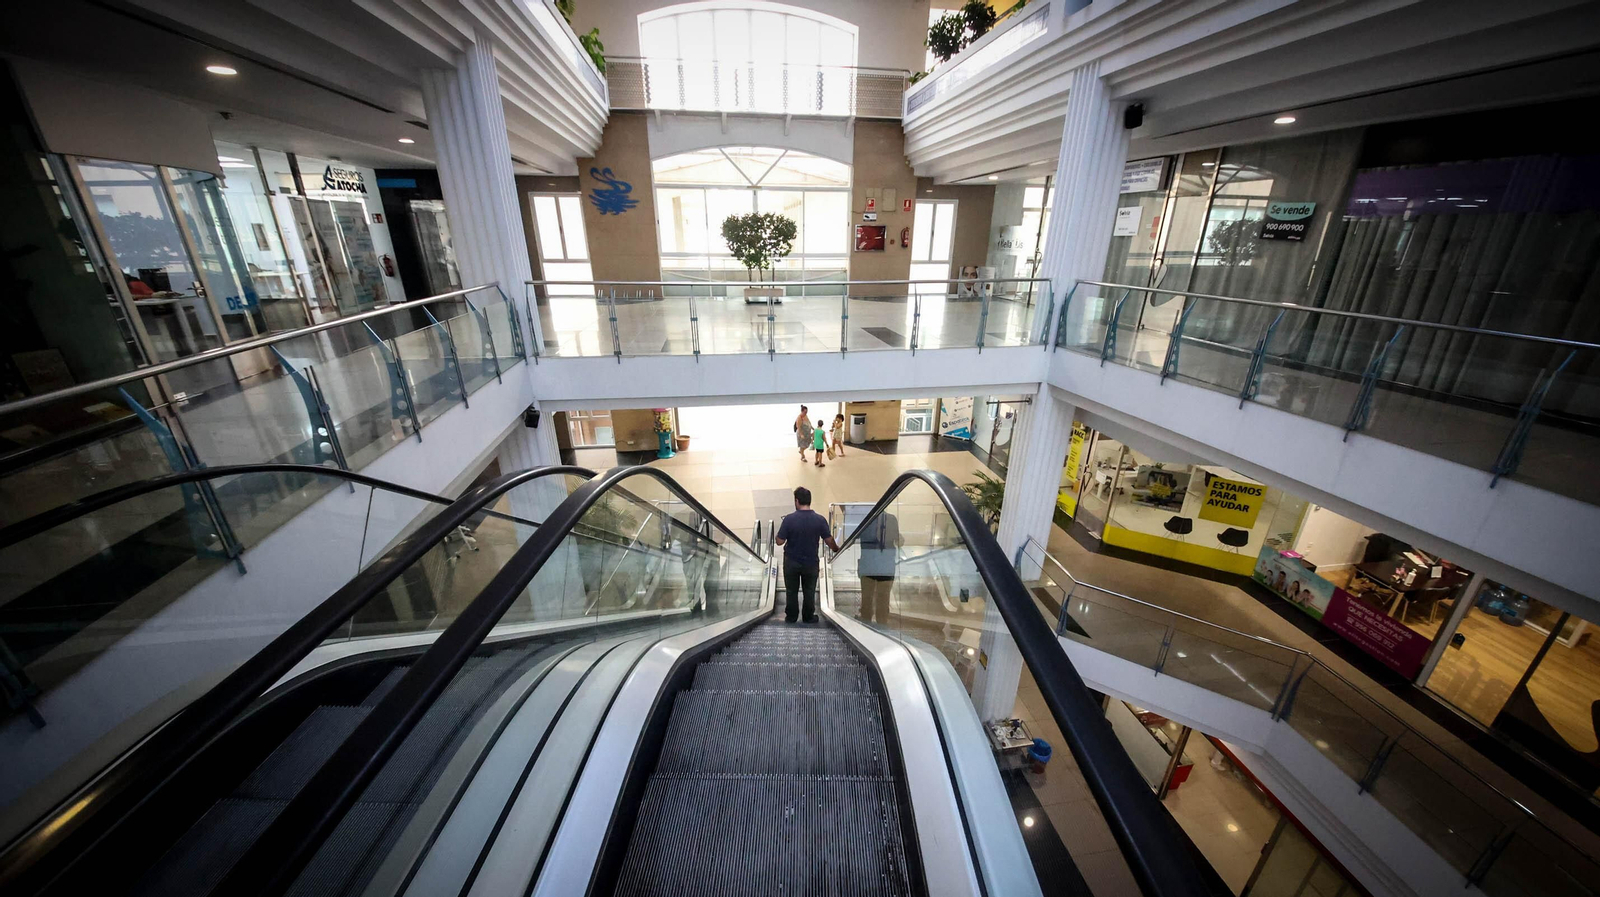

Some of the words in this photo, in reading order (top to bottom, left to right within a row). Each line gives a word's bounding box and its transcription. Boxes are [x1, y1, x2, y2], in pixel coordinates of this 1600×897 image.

[333, 168, 364, 182] SEGUROS
[337, 181, 367, 193] ATOCHA
[1271, 205, 1281, 214] Se
[1283, 205, 1310, 215] vende
[1210, 490, 1237, 501] PARA
[1212, 481, 1262, 497] ESTAMOS
[1207, 499, 1250, 513] AYUDAR
[1348, 606, 1362, 618] QUE
[1364, 615, 1403, 642] NECESITAS
